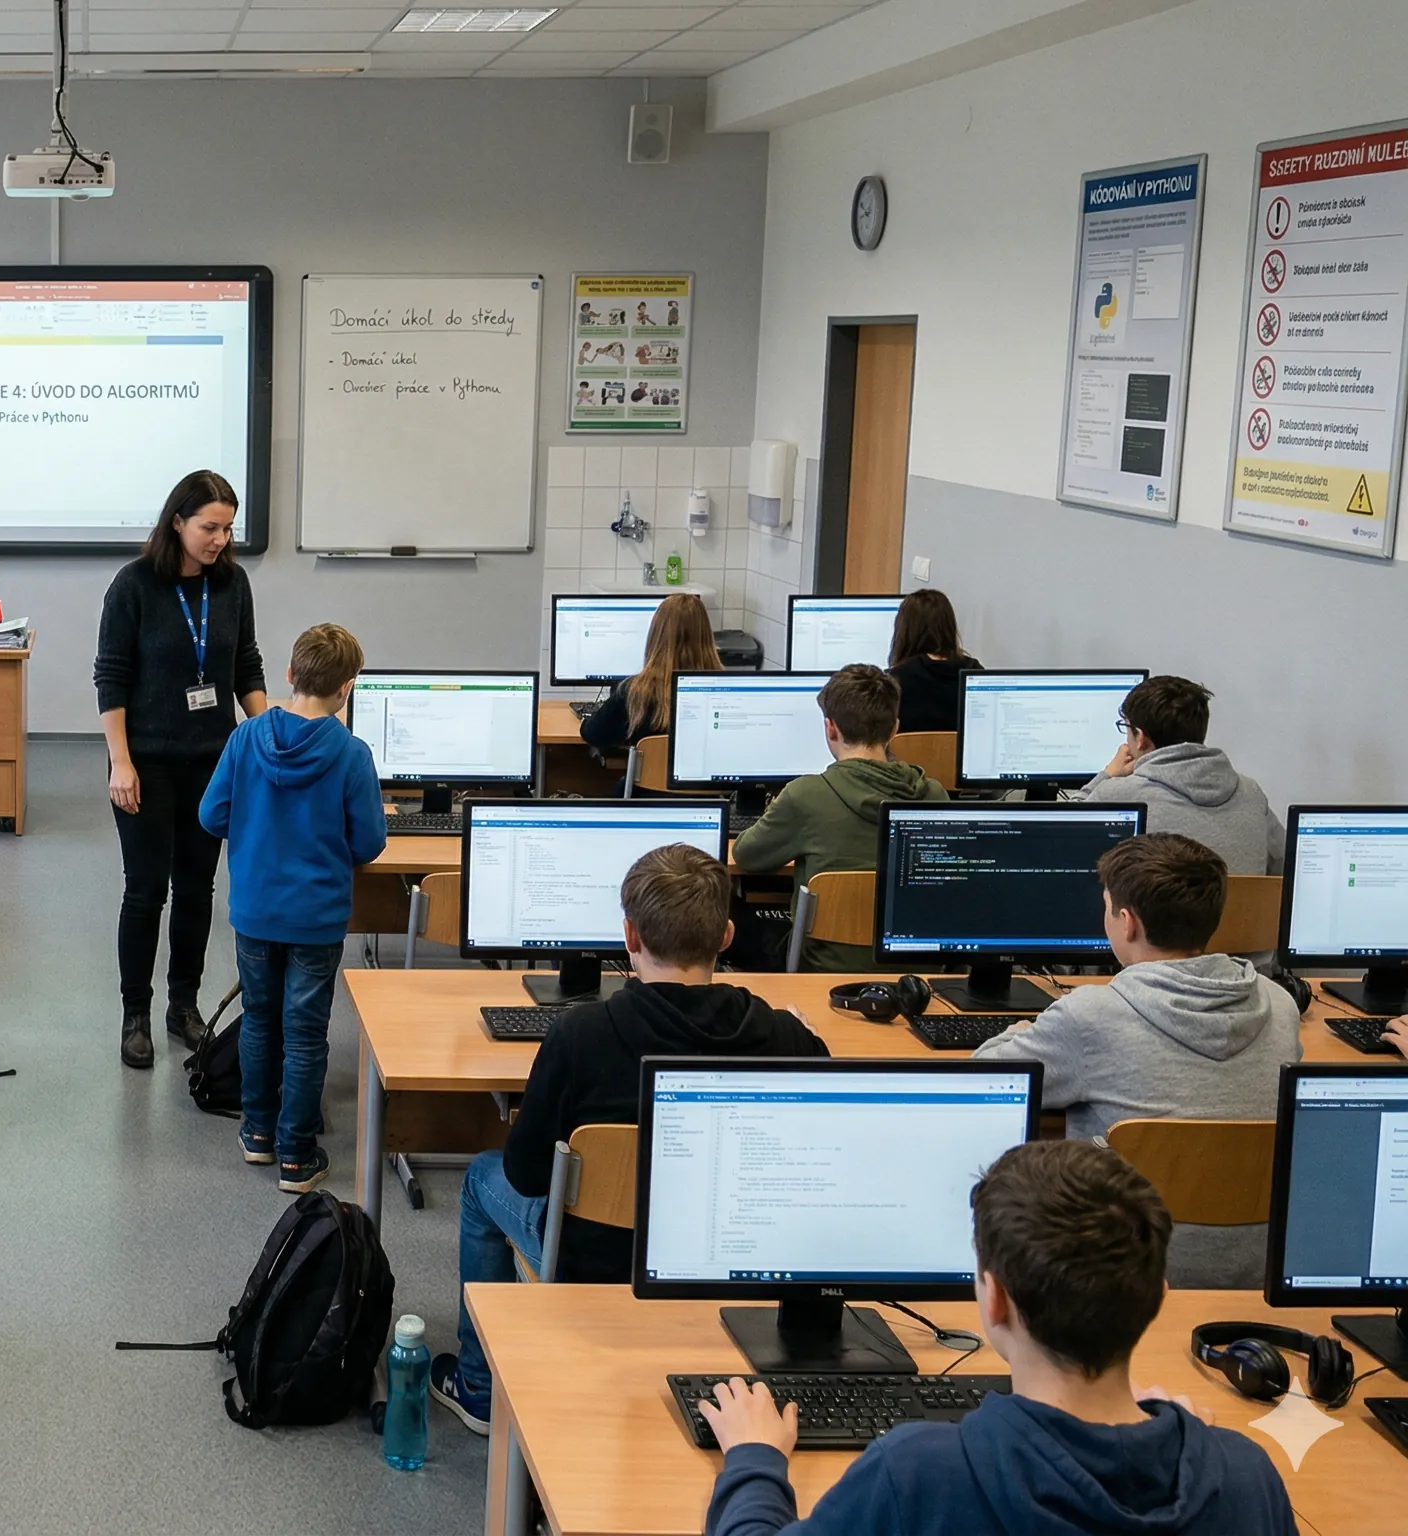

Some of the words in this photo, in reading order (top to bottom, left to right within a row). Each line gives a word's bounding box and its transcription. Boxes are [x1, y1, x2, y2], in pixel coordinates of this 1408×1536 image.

[329, 308, 391, 327] Domácí
[401, 308, 434, 327] úkol
[445, 309, 462, 326] do
[471, 307, 515, 337] středy
[341, 351, 387, 366] Domácí
[391, 351, 418, 365] úkol
[12, 384, 27, 399] 4:
[31, 381, 76, 399] ÚVOD
[80, 384, 103, 399] DO
[107, 381, 200, 399] ALGORITMŮ
[439, 385, 446, 393] v
[453, 377, 501, 400] Pythonu
[32, 414, 39, 423] v
[42, 411, 89, 425] Pythonu
